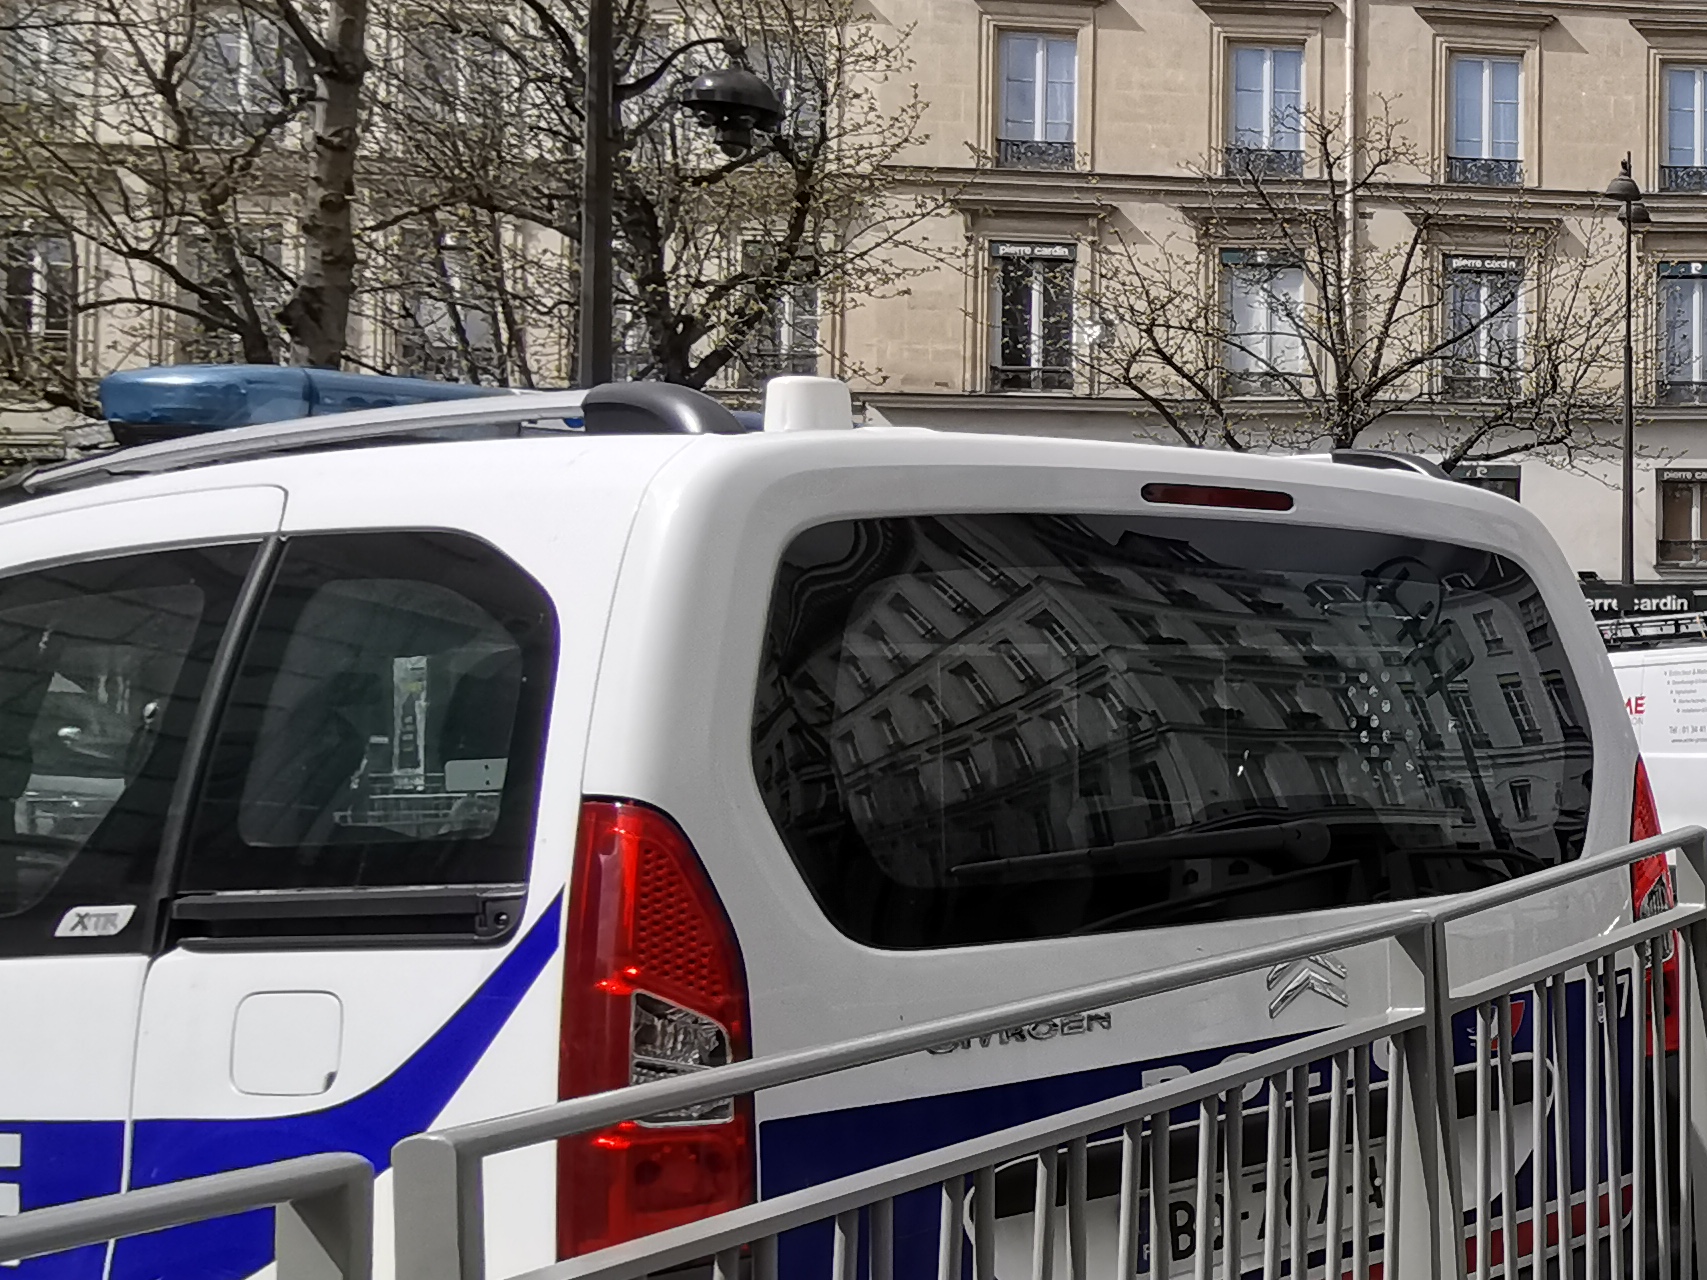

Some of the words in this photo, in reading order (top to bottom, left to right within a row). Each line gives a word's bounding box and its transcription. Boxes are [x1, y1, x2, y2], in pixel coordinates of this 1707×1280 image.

[1485, 259, 1516, 268] cardn
[1664, 470, 1693, 480] pierre
[69, 913, 119, 931] XTR
